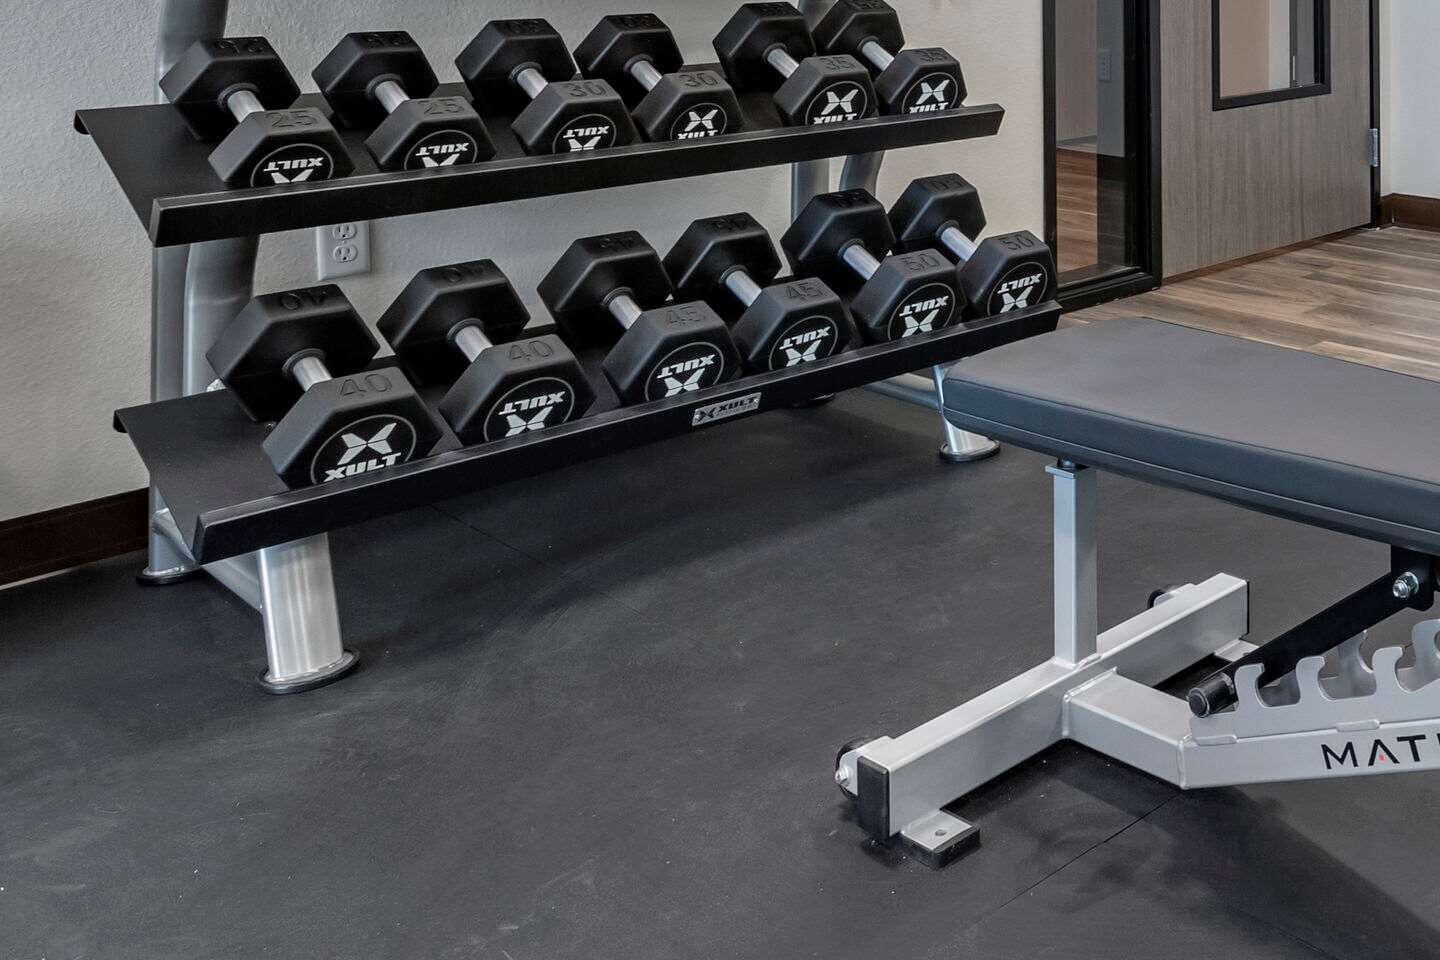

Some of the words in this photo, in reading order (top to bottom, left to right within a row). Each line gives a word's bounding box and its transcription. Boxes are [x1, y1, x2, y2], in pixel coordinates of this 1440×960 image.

[563, 125, 610, 138] XULT
[416, 142, 470, 156] XULT
[263, 157, 324, 172] XULT
[997, 273, 1042, 294] XULT
[899, 295, 949, 317] XULT
[779, 326, 831, 350] XULT
[657, 354, 715, 379] XULT
[498, 391, 566, 416] XULT
[324, 452, 401, 482] XULT
